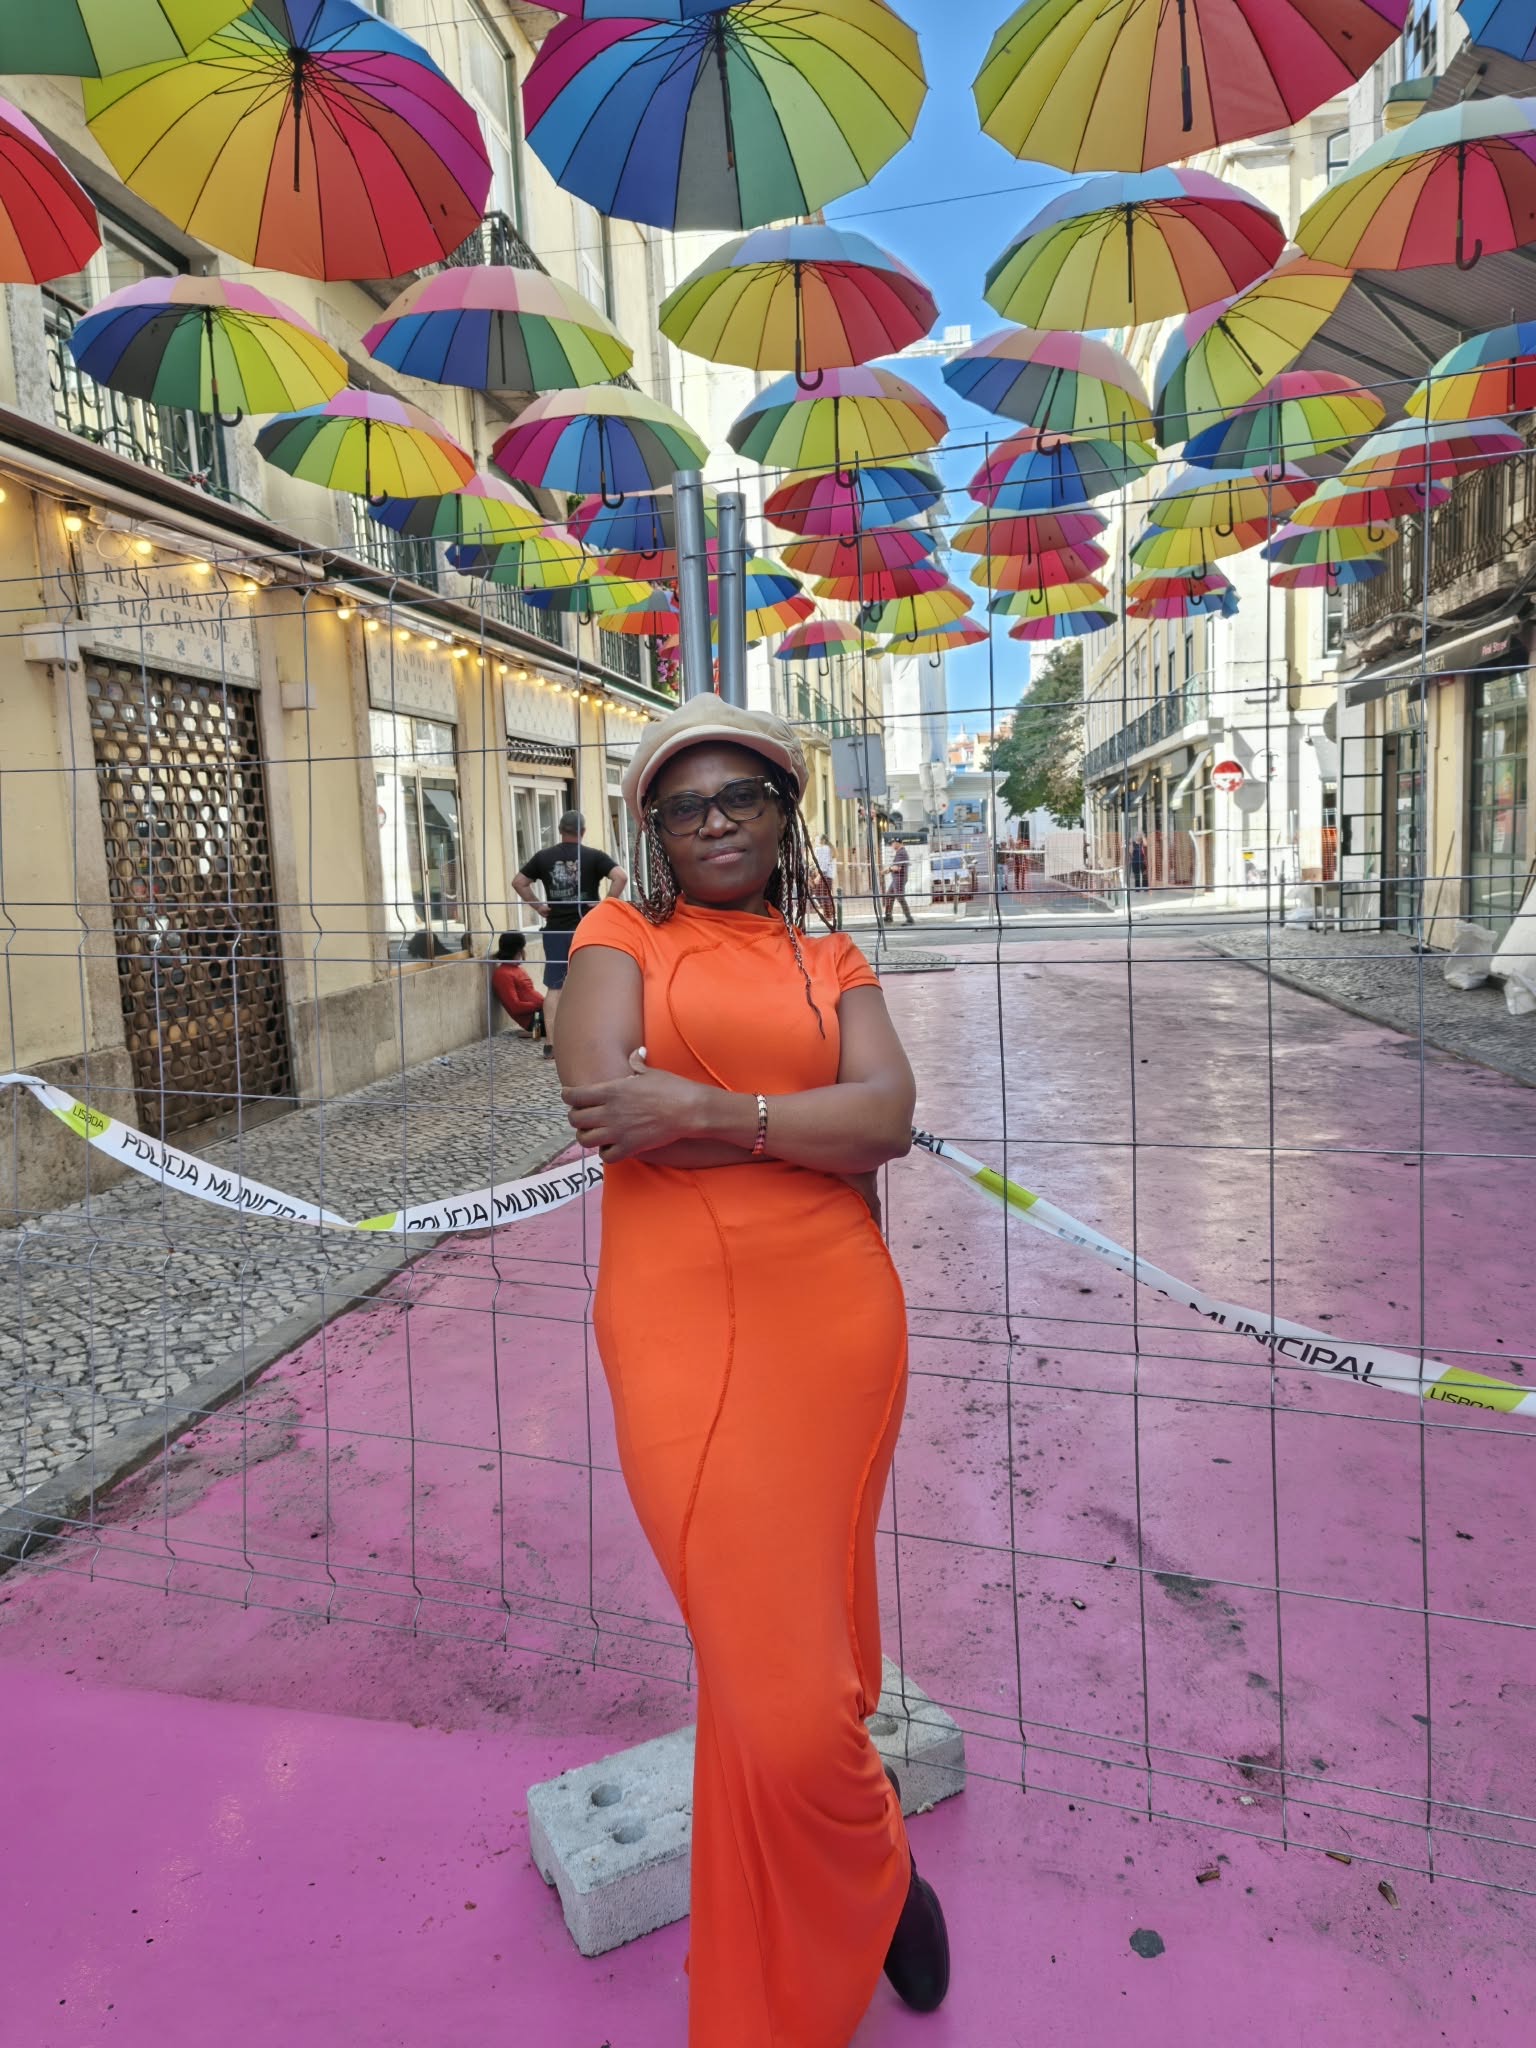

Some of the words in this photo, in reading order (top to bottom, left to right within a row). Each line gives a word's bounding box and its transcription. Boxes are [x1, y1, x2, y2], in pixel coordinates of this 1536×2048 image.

[104, 562, 234, 620] RESTAURANTE
[117, 594, 151, 622] RIO
[160, 607, 232, 644] GRANDE
[72, 1105, 105, 1131] LISBOA
[493, 1163, 604, 1219] MUNICIPA
